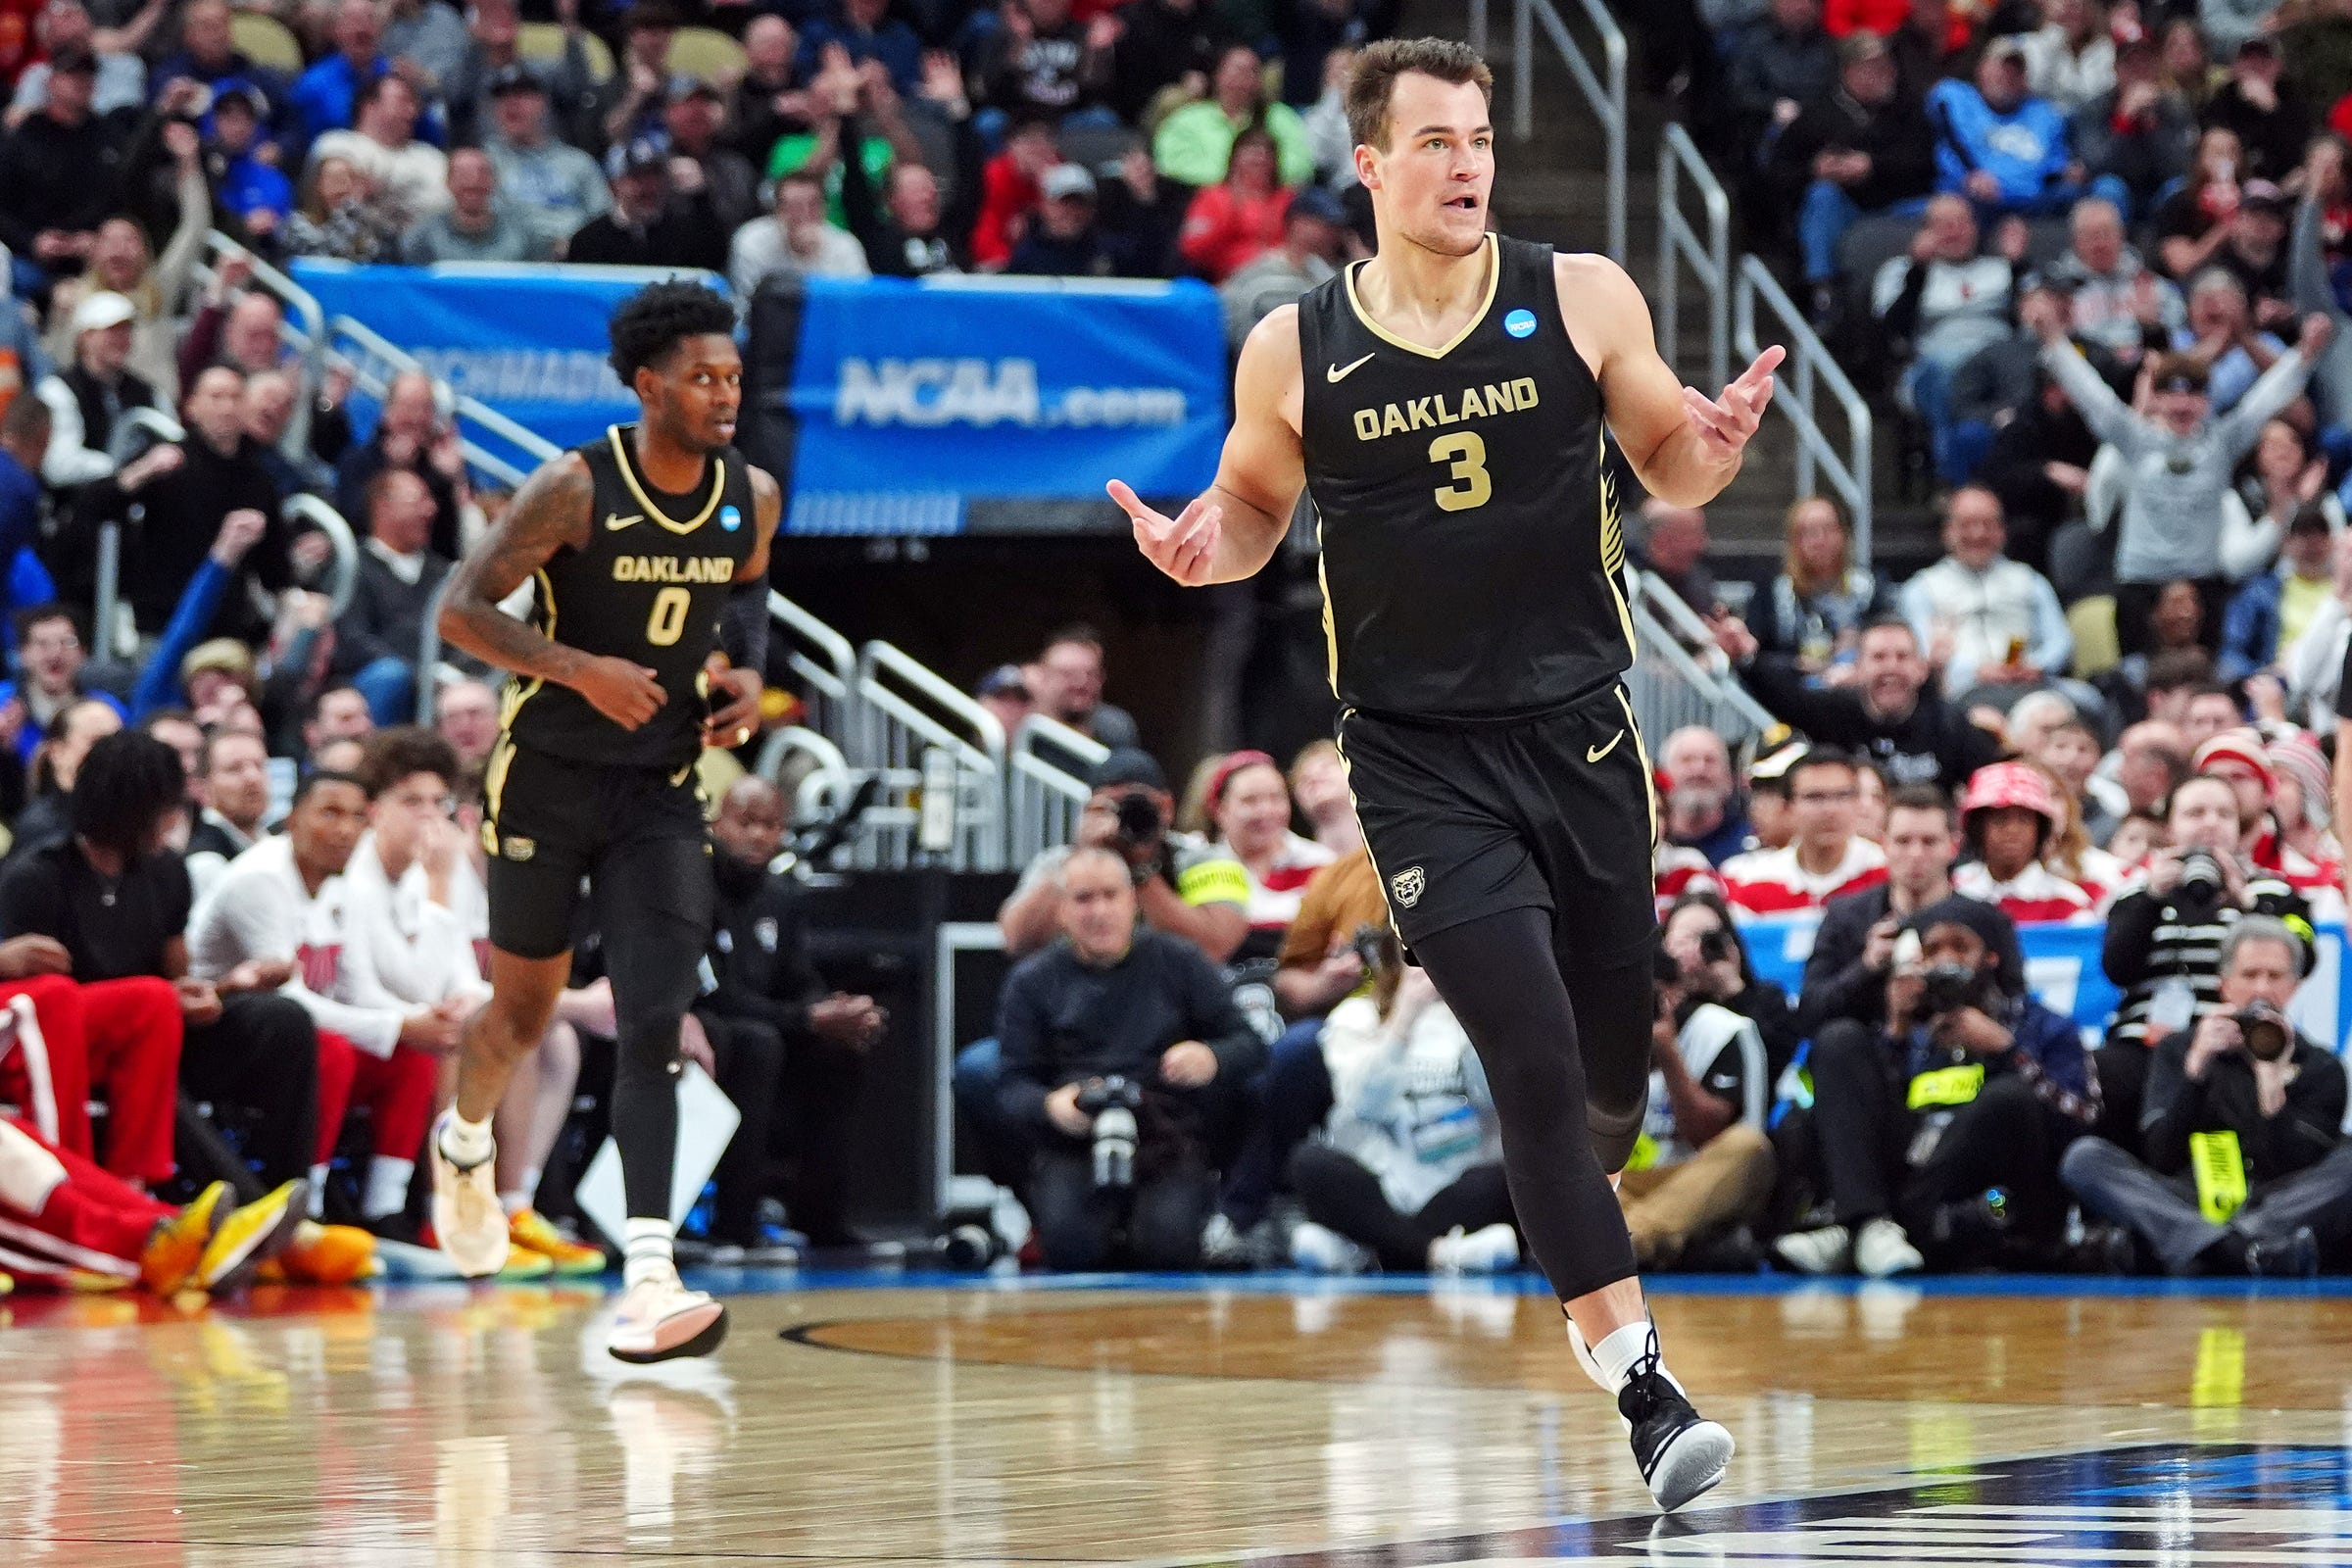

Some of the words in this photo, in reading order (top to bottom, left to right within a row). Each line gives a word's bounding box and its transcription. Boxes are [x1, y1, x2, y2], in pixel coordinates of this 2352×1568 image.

[1353, 376, 1540, 441] OAKLAND
[1428, 430, 1492, 513] 3
[612, 555, 735, 583] OAKLAND
[646, 586, 691, 647] 0
